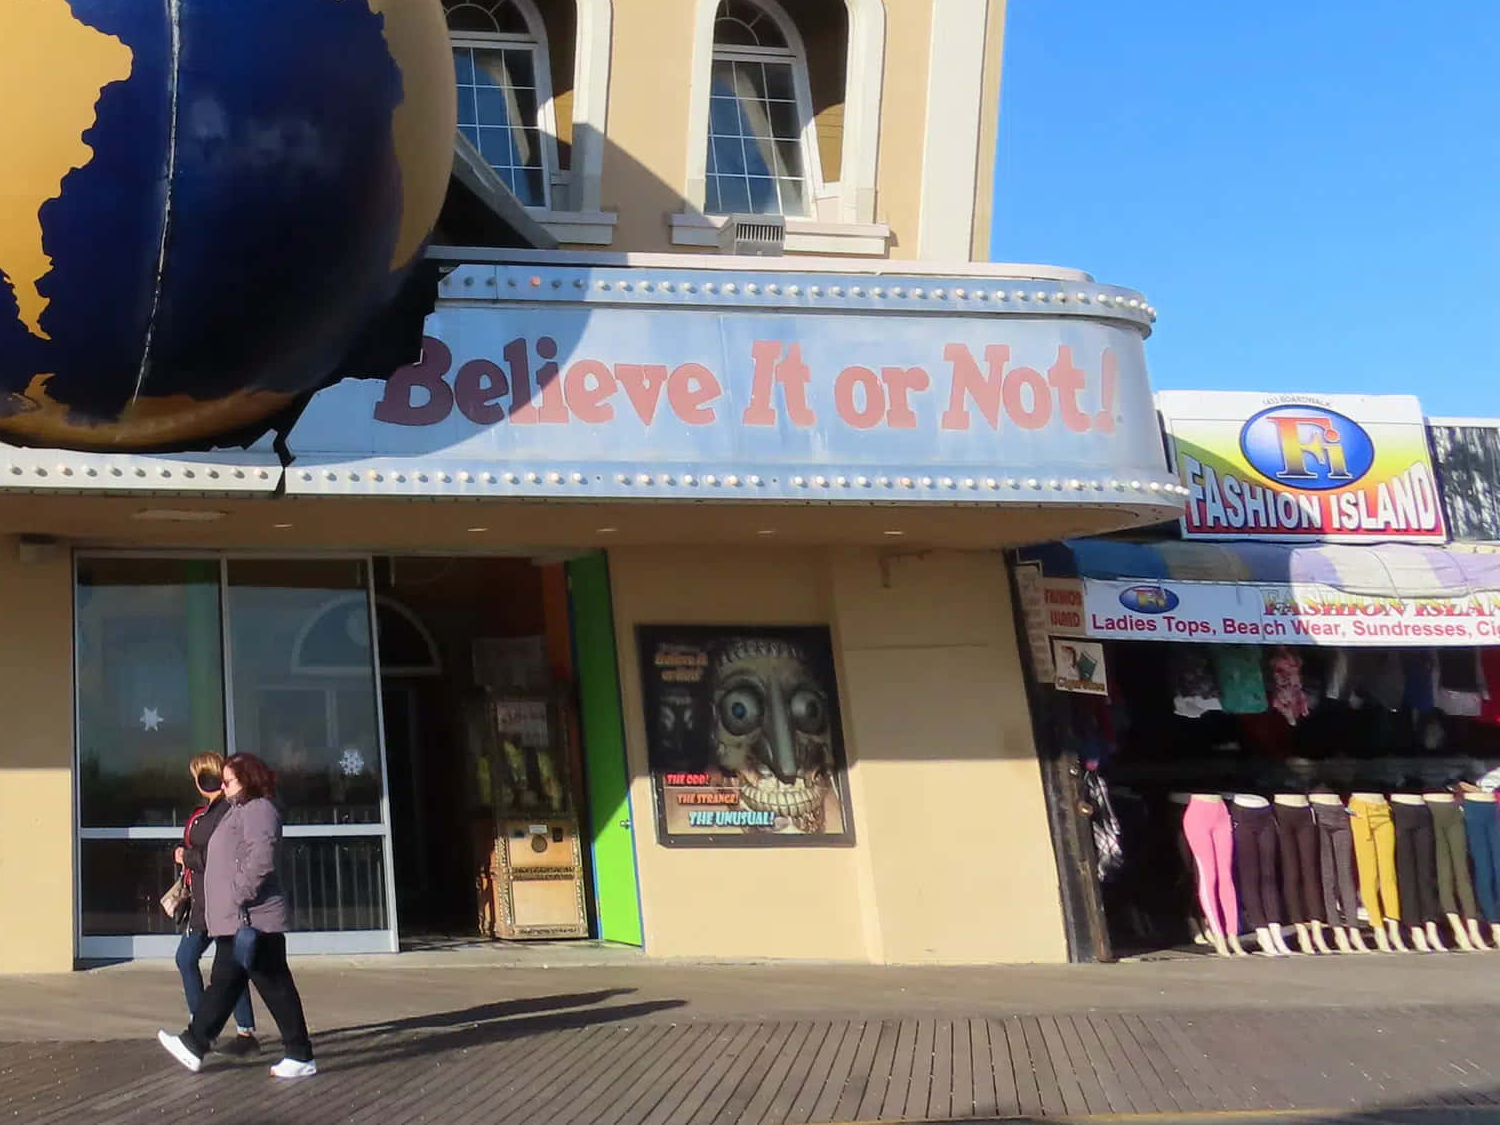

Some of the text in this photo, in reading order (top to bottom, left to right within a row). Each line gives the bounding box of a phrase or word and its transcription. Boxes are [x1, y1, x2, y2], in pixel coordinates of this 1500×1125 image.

[373, 335, 1120, 434] Believe It or Not!
[1183, 453, 1437, 531] FASHION ISLAND
[1092, 614, 1157, 632] Ladies
[1163, 616, 1217, 636] Tops,
[1222, 618, 1286, 636] Beach
[1292, 621, 1347, 638] Wear,
[1353, 621, 1473, 639] Sundresses,
[677, 793, 740, 805] THE STRANGE!
[689, 811, 775, 826] THE UNUSUAL!
